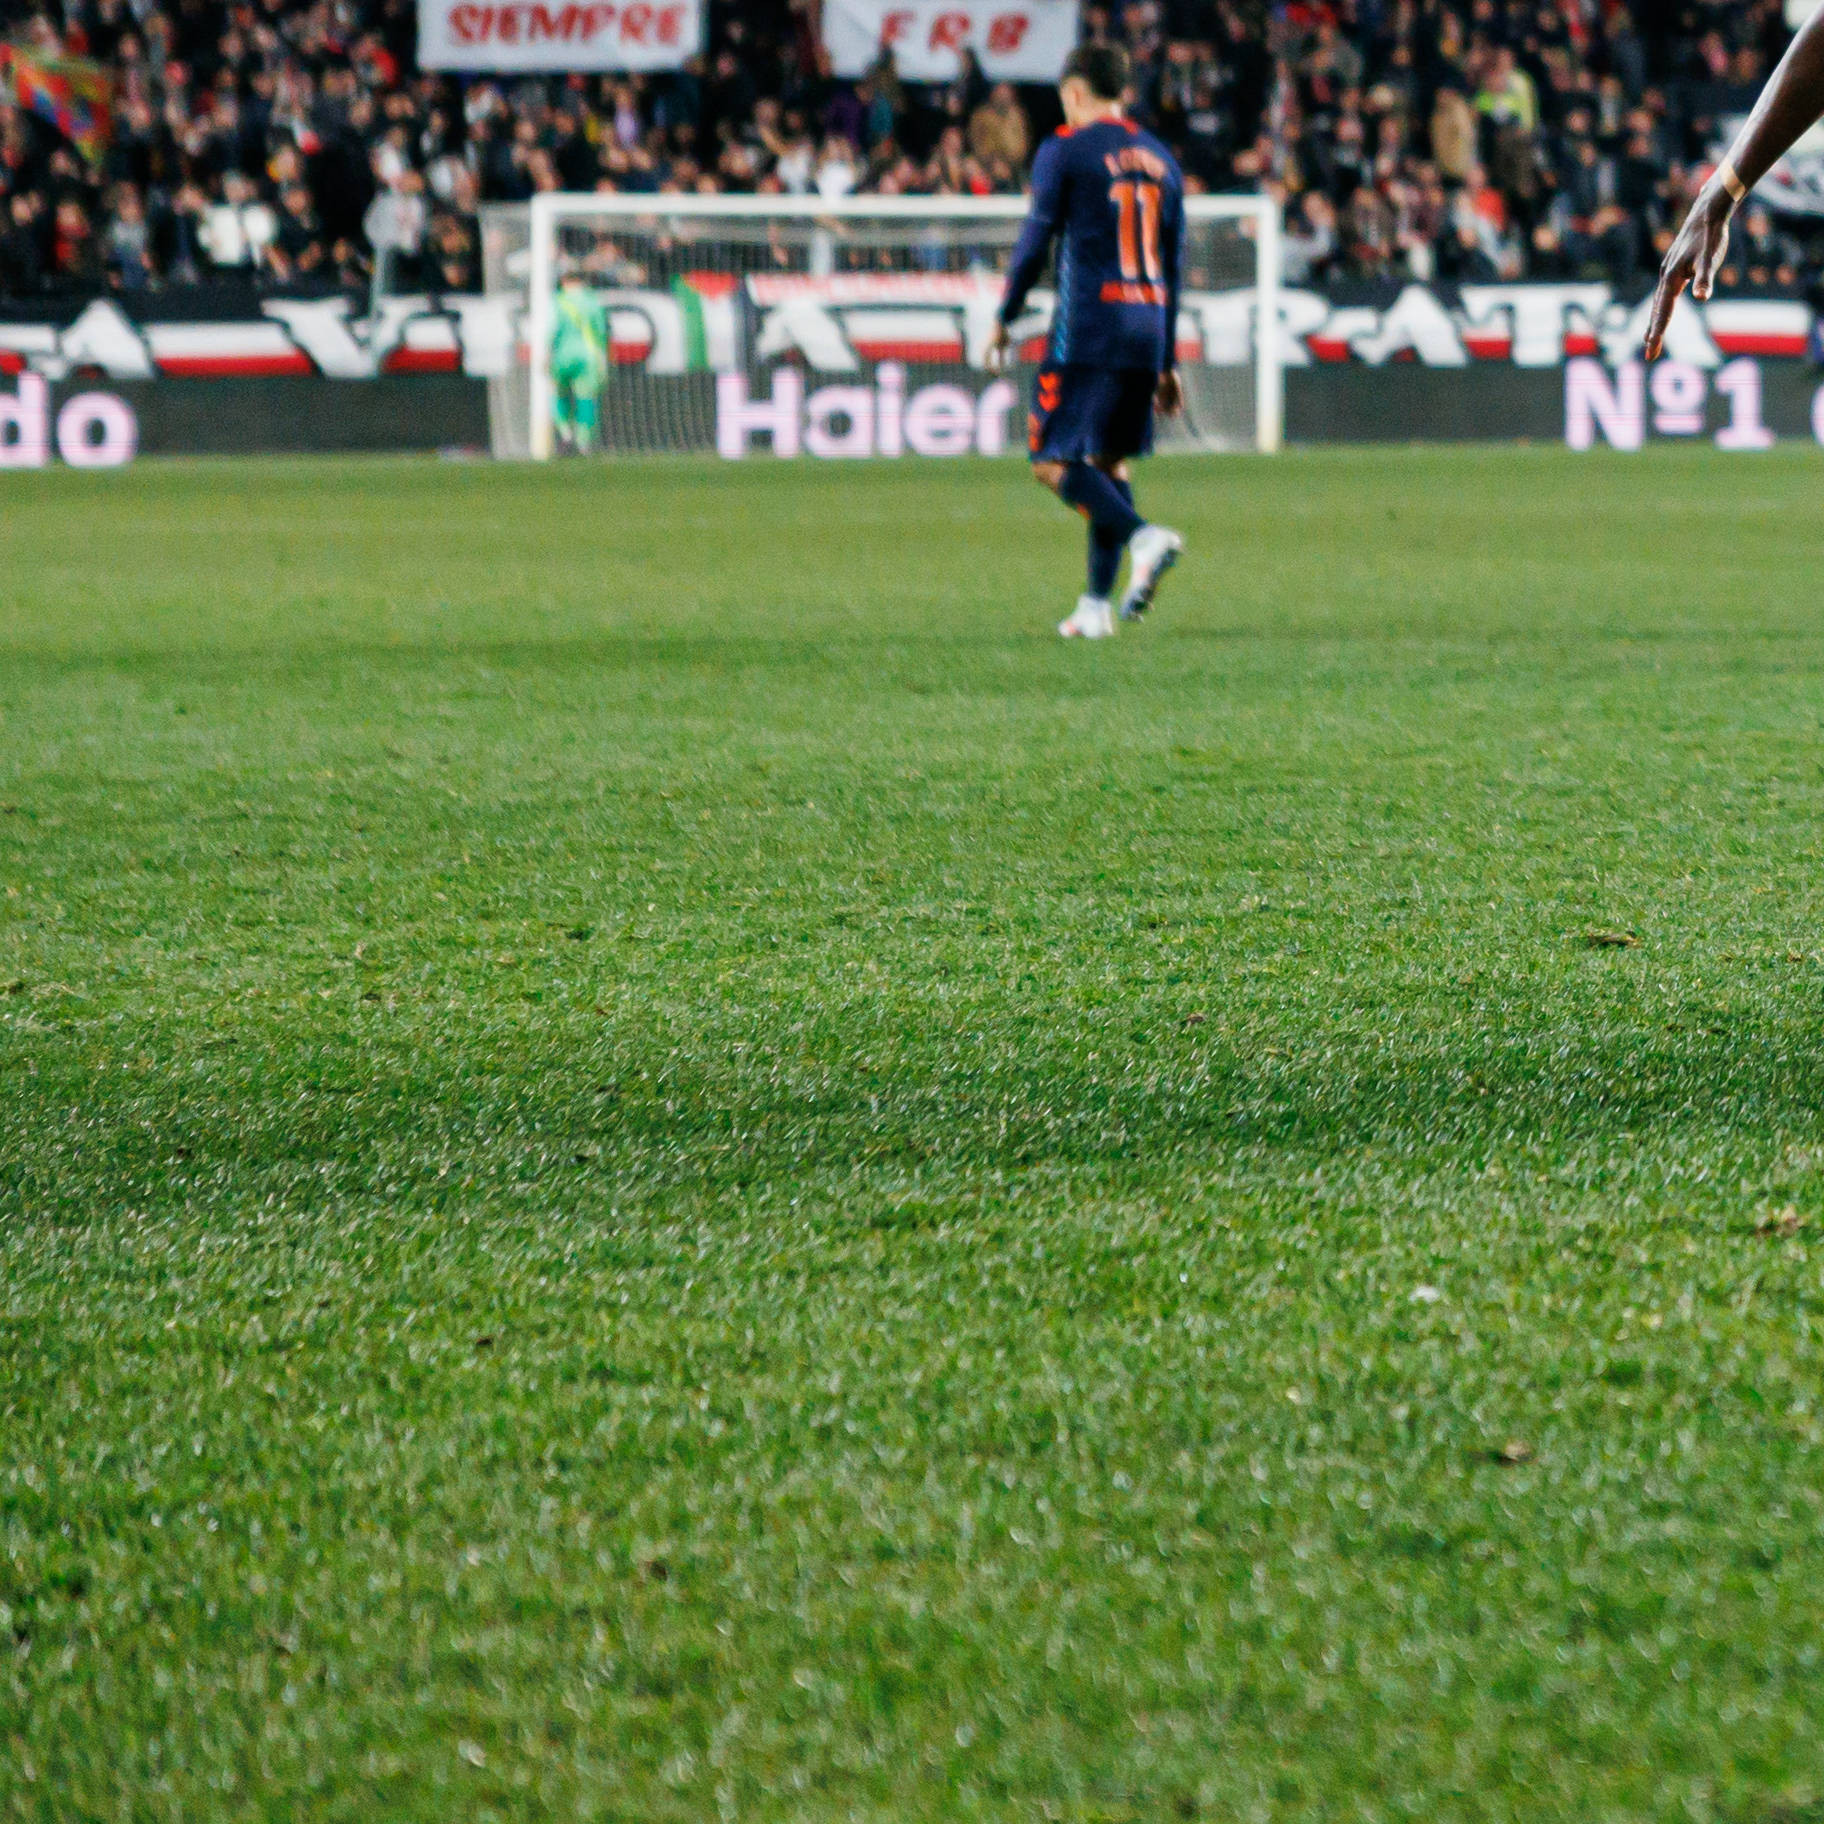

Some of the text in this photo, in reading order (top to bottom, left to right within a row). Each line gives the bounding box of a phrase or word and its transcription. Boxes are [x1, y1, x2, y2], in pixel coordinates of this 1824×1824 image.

[449, 1, 688, 48] SIEMPRE
[1108, 180, 1162, 281] 11
[715, 362, 1019, 460] Haier
